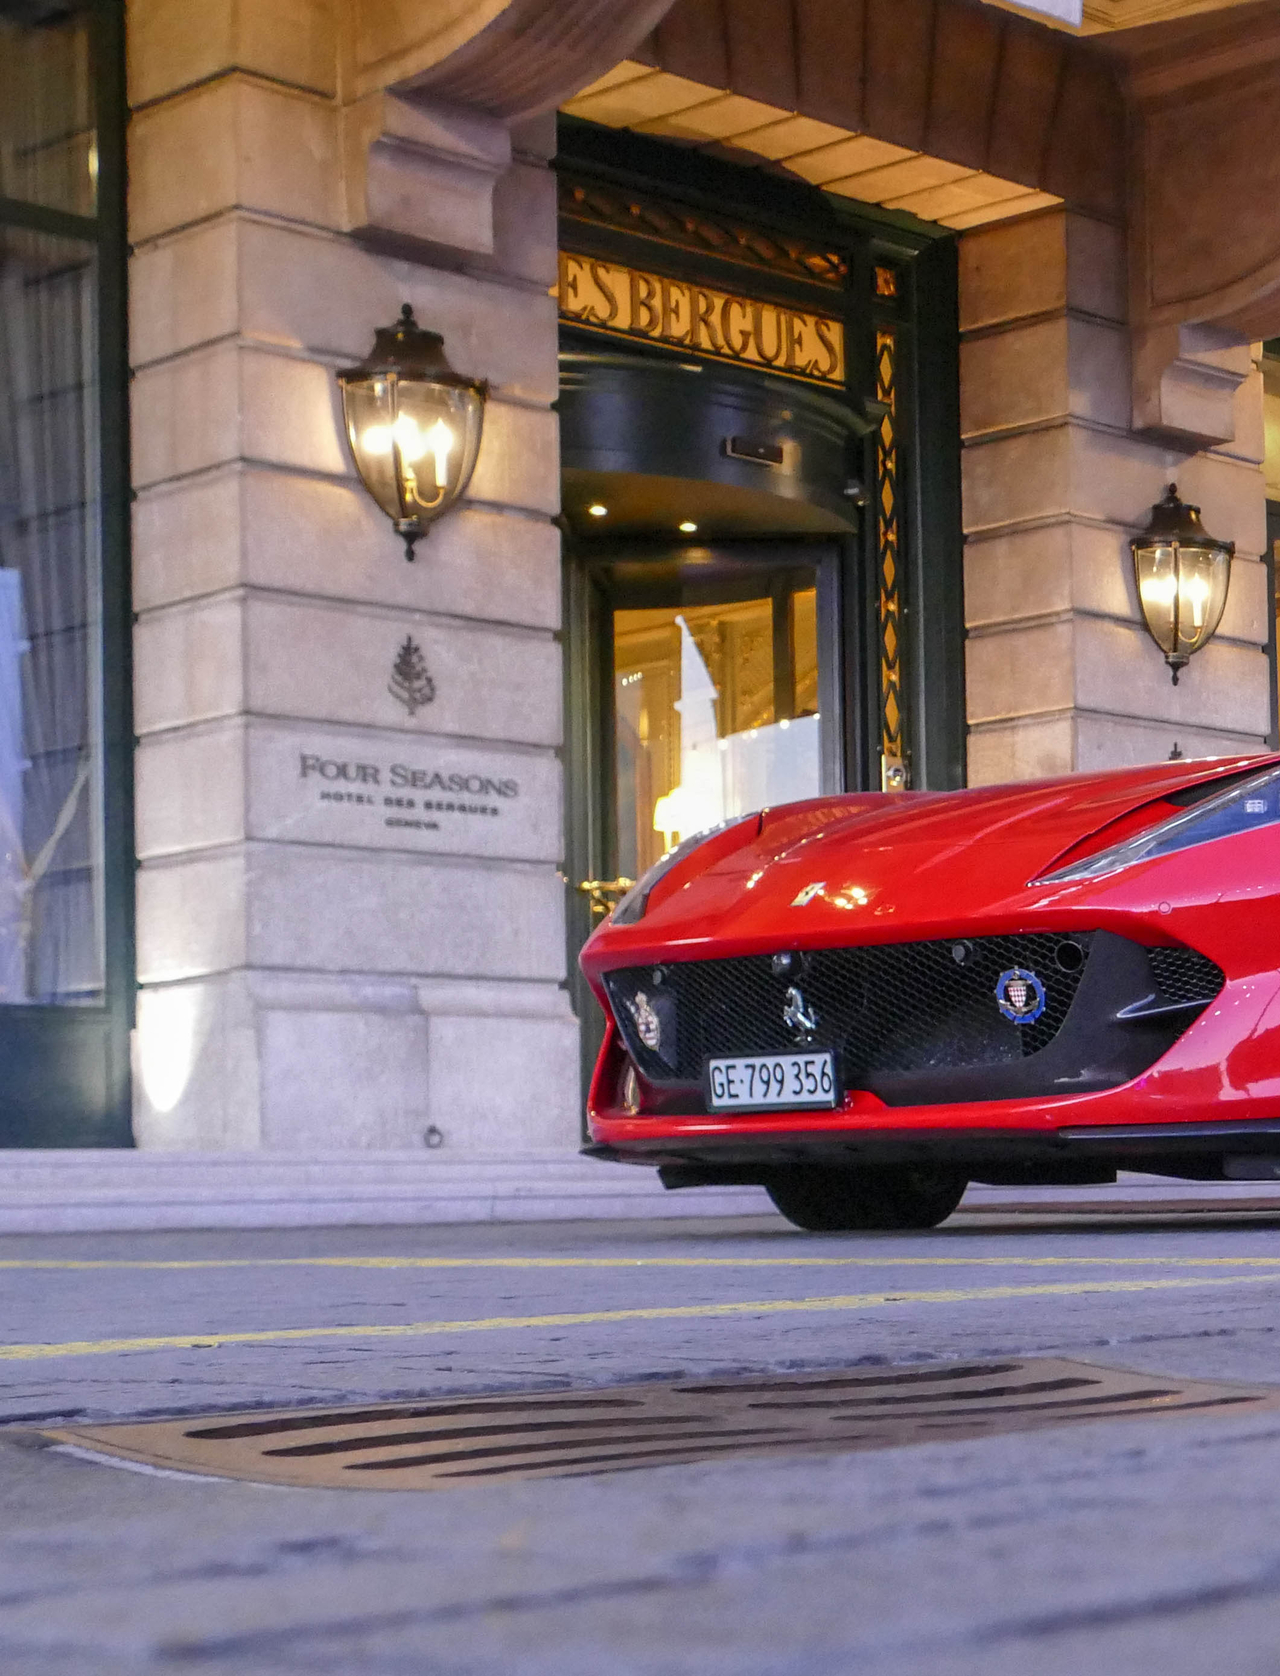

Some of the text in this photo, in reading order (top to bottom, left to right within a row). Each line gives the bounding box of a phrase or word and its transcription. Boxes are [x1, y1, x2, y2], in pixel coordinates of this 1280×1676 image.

[630, 266, 838, 378] BERGUES
[300, 753, 518, 798] FOUR SEASONS
[791, 1059, 832, 1095] 356
